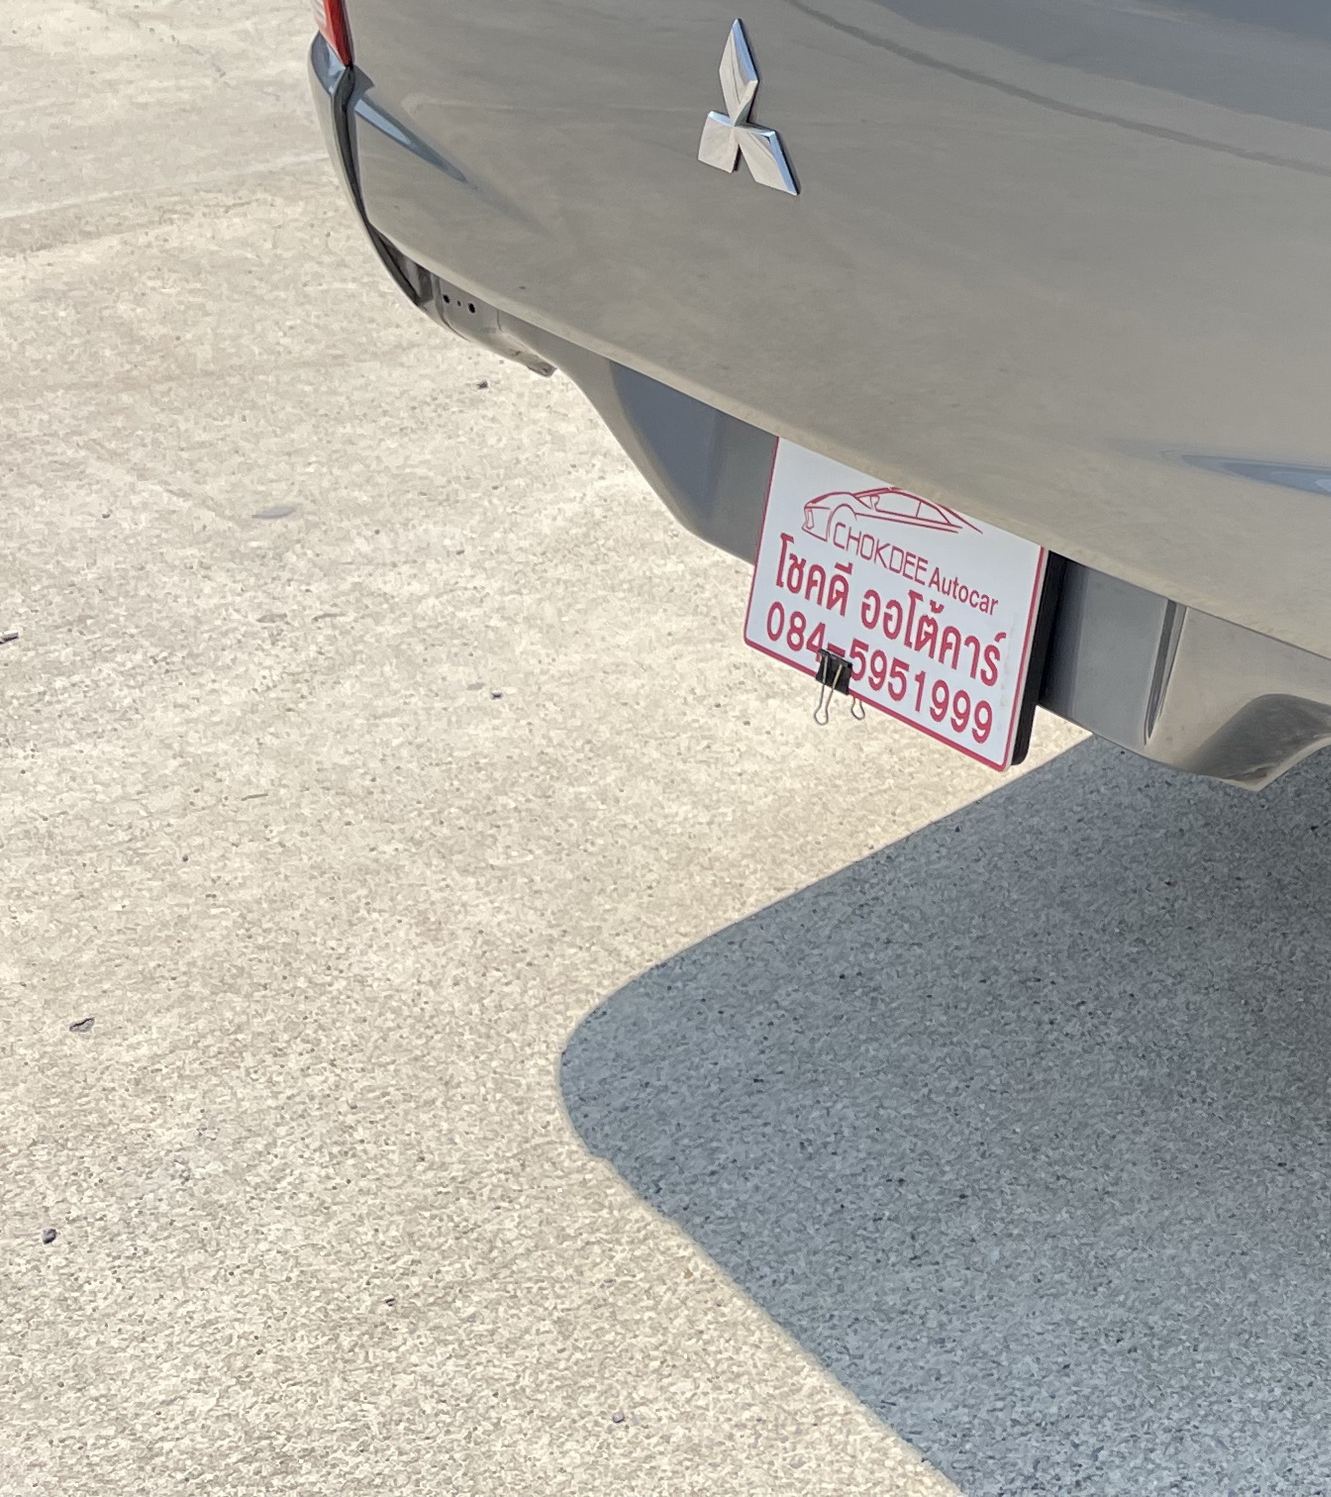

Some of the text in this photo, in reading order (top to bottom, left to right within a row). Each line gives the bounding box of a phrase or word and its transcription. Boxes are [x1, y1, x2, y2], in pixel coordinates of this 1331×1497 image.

[776, 533, 1007, 687] โชคดี ออโต้คาร์
[832, 522, 999, 615] CHOKDEE Autocar
[766, 601, 993, 745] 084-5951999
